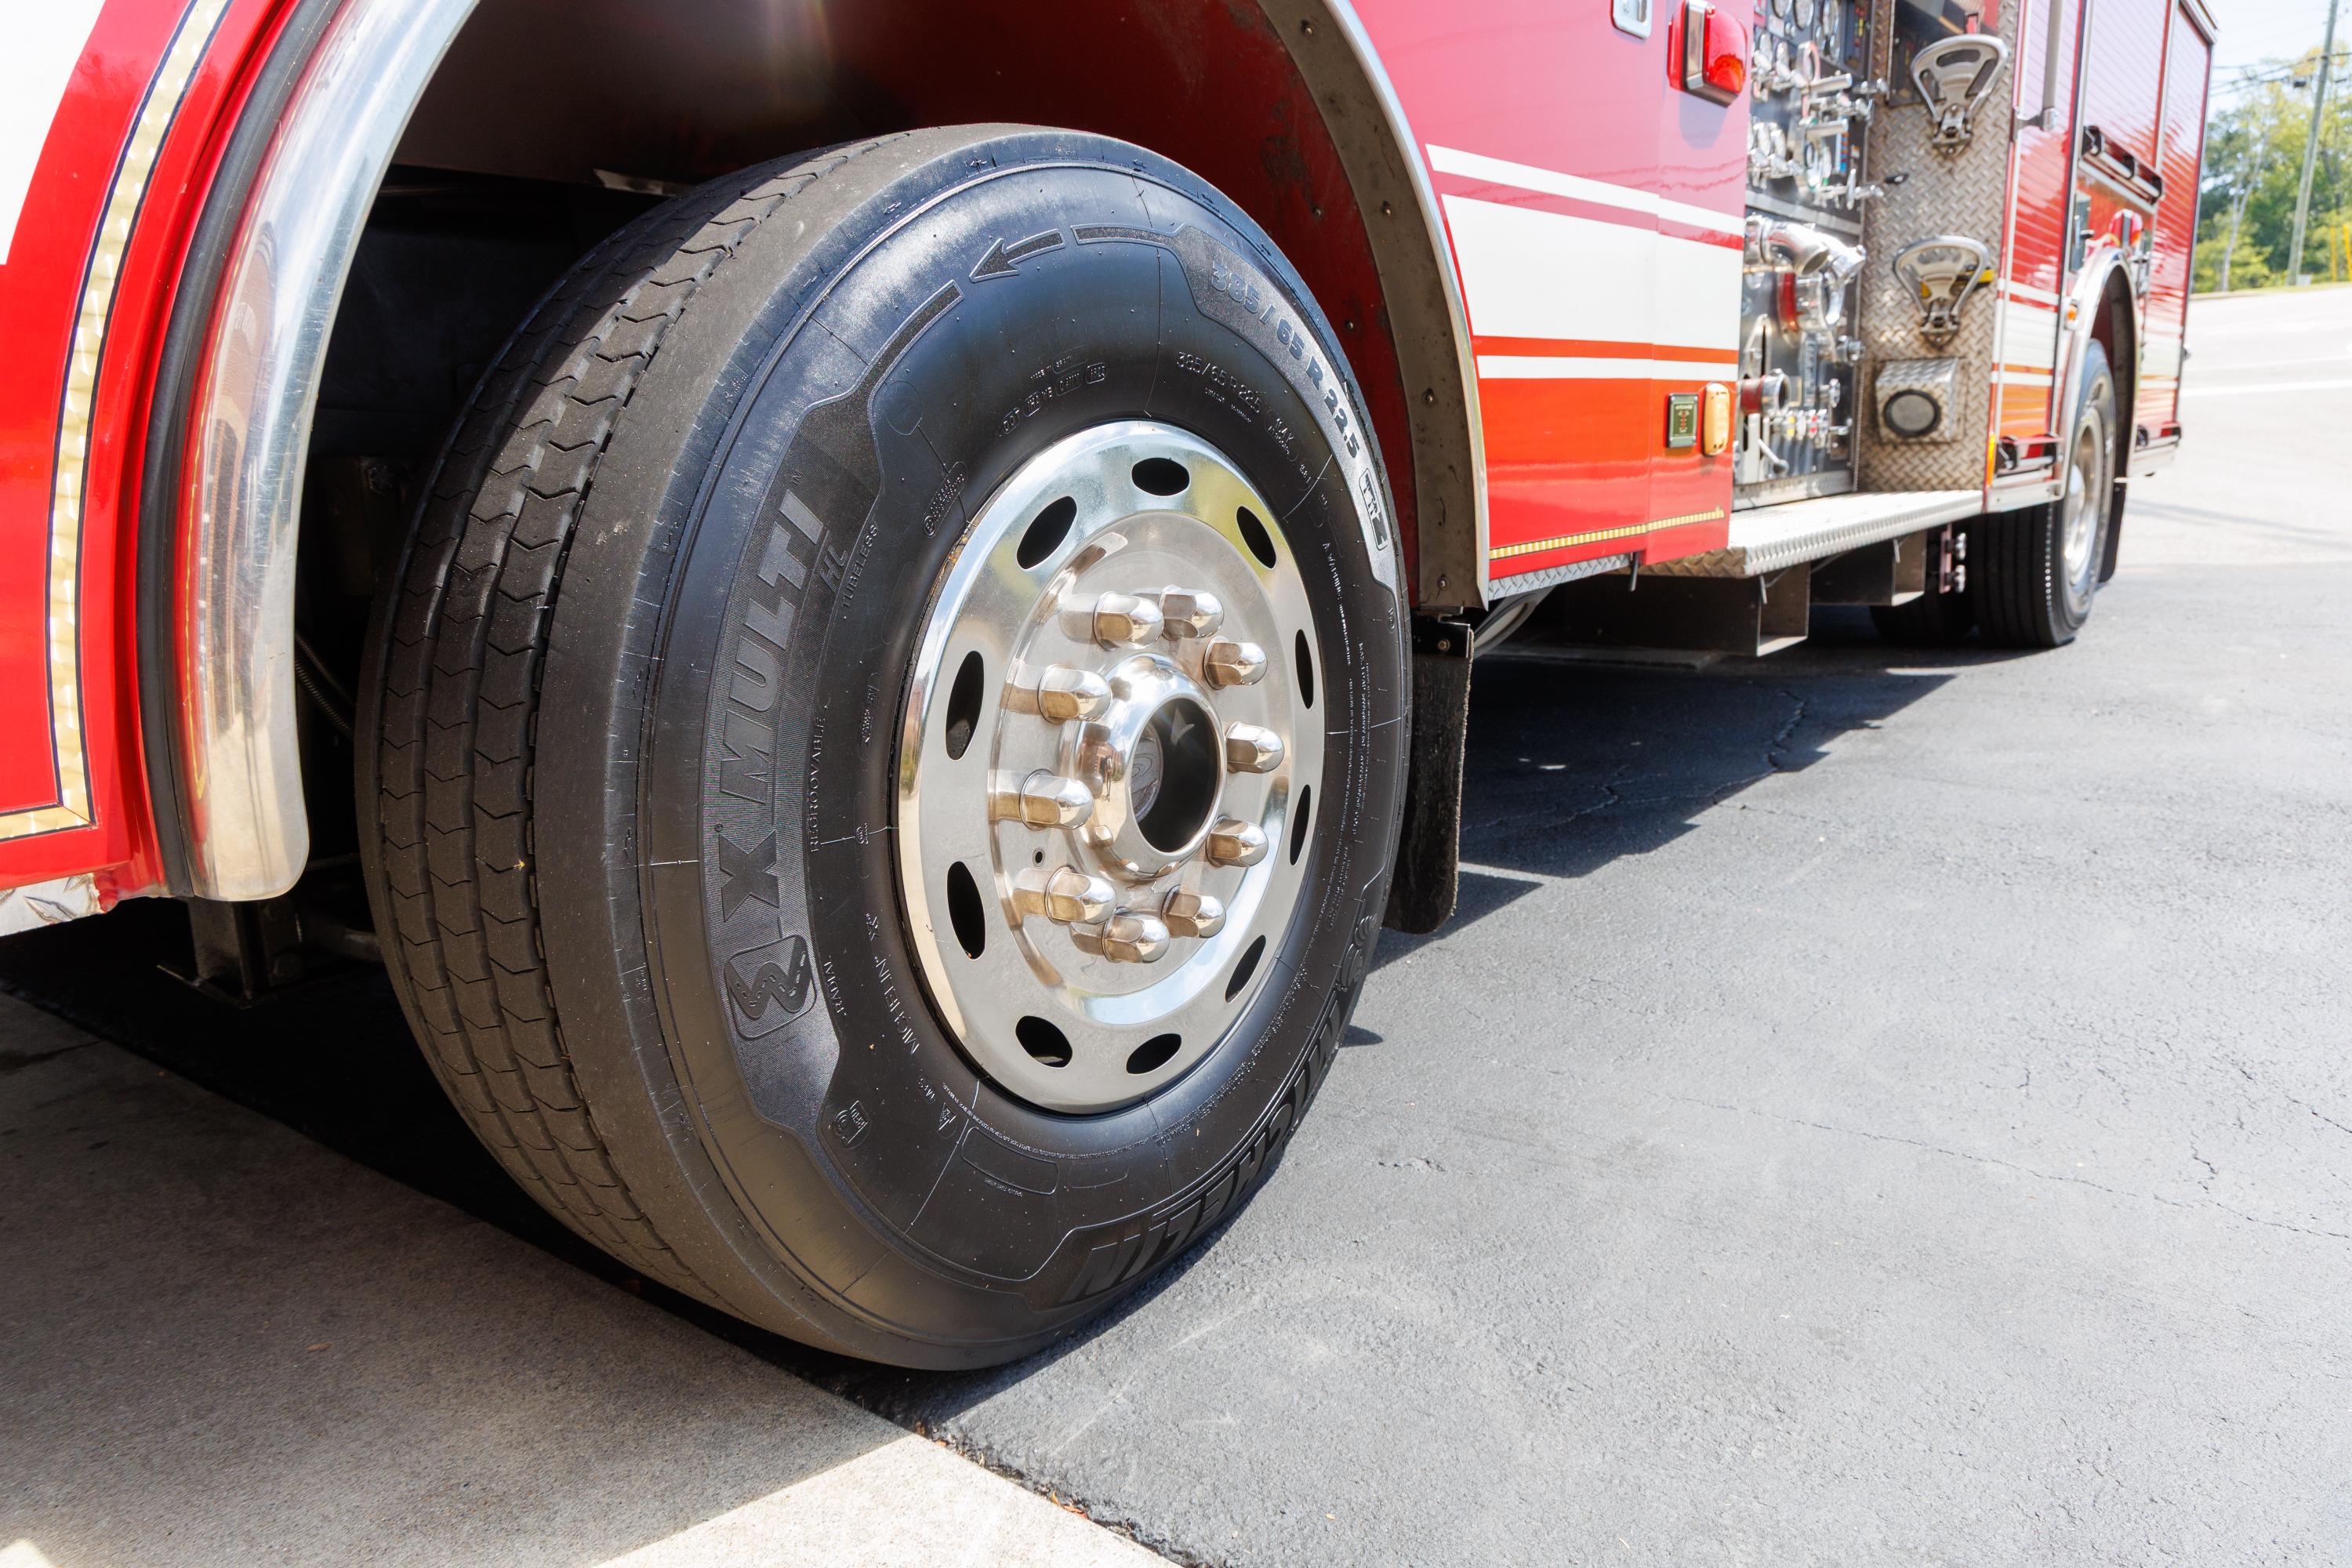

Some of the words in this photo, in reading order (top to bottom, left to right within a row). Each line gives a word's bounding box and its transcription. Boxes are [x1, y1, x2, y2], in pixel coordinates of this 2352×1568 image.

[1003, 408, 1021, 432] DOT
[1324, 388, 1360, 459] 22.5
[819, 545, 849, 593] HL
[842, 524, 879, 607] TUBELESS
[720, 488, 824, 804] MULTI
[809, 716, 826, 853] REGROOVABLE
[822, 955, 846, 1015] RADIAL
